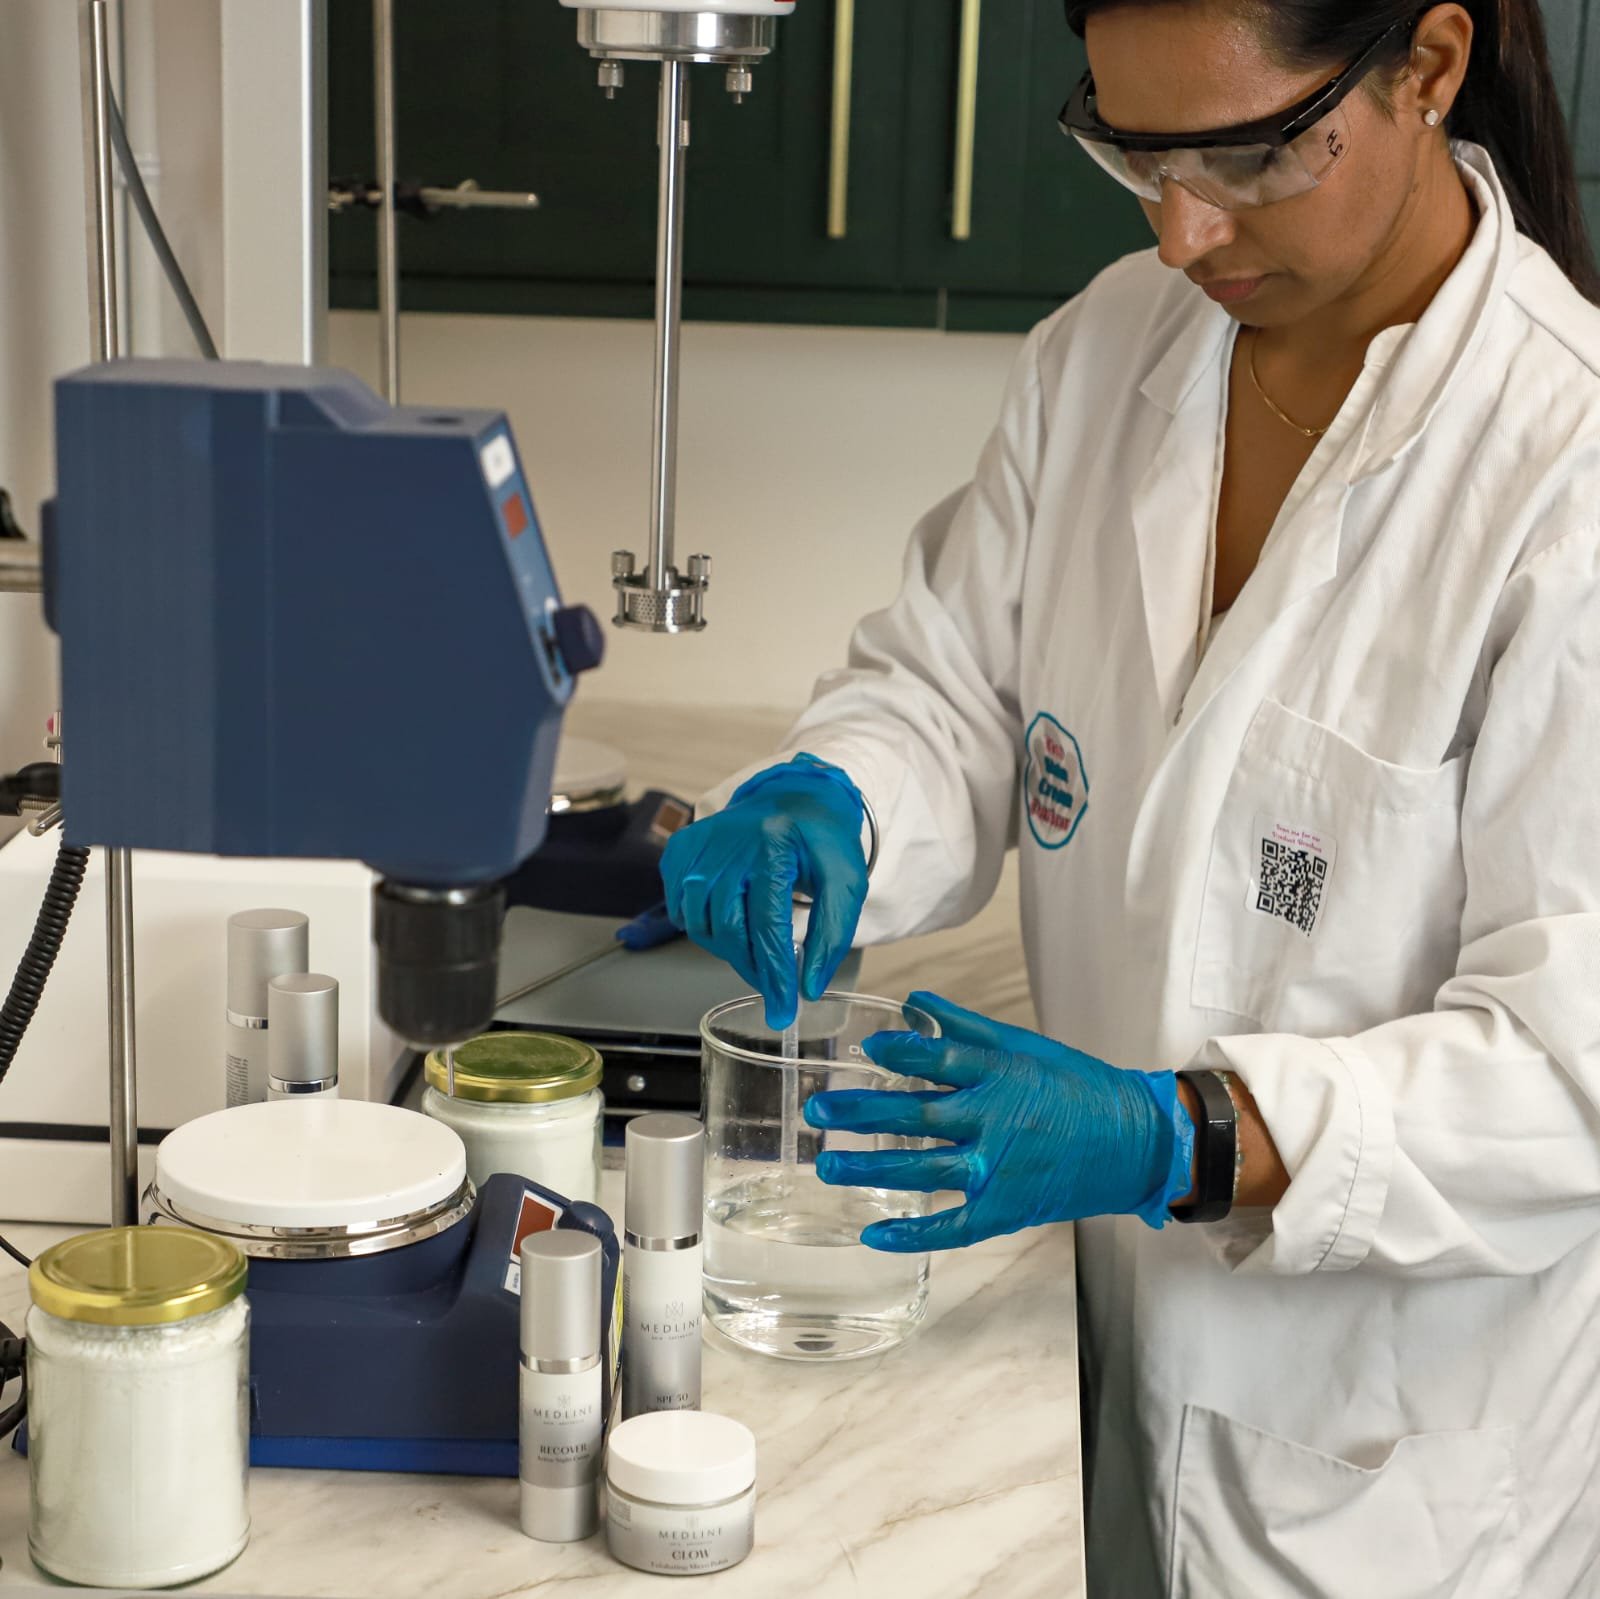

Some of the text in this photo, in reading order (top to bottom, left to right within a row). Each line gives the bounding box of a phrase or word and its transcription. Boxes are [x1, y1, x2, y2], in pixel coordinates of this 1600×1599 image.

[677, 1391, 689, 1402] 50
[540, 1442, 588, 1455] RECOVER
[671, 1548, 709, 1561] GLOW
